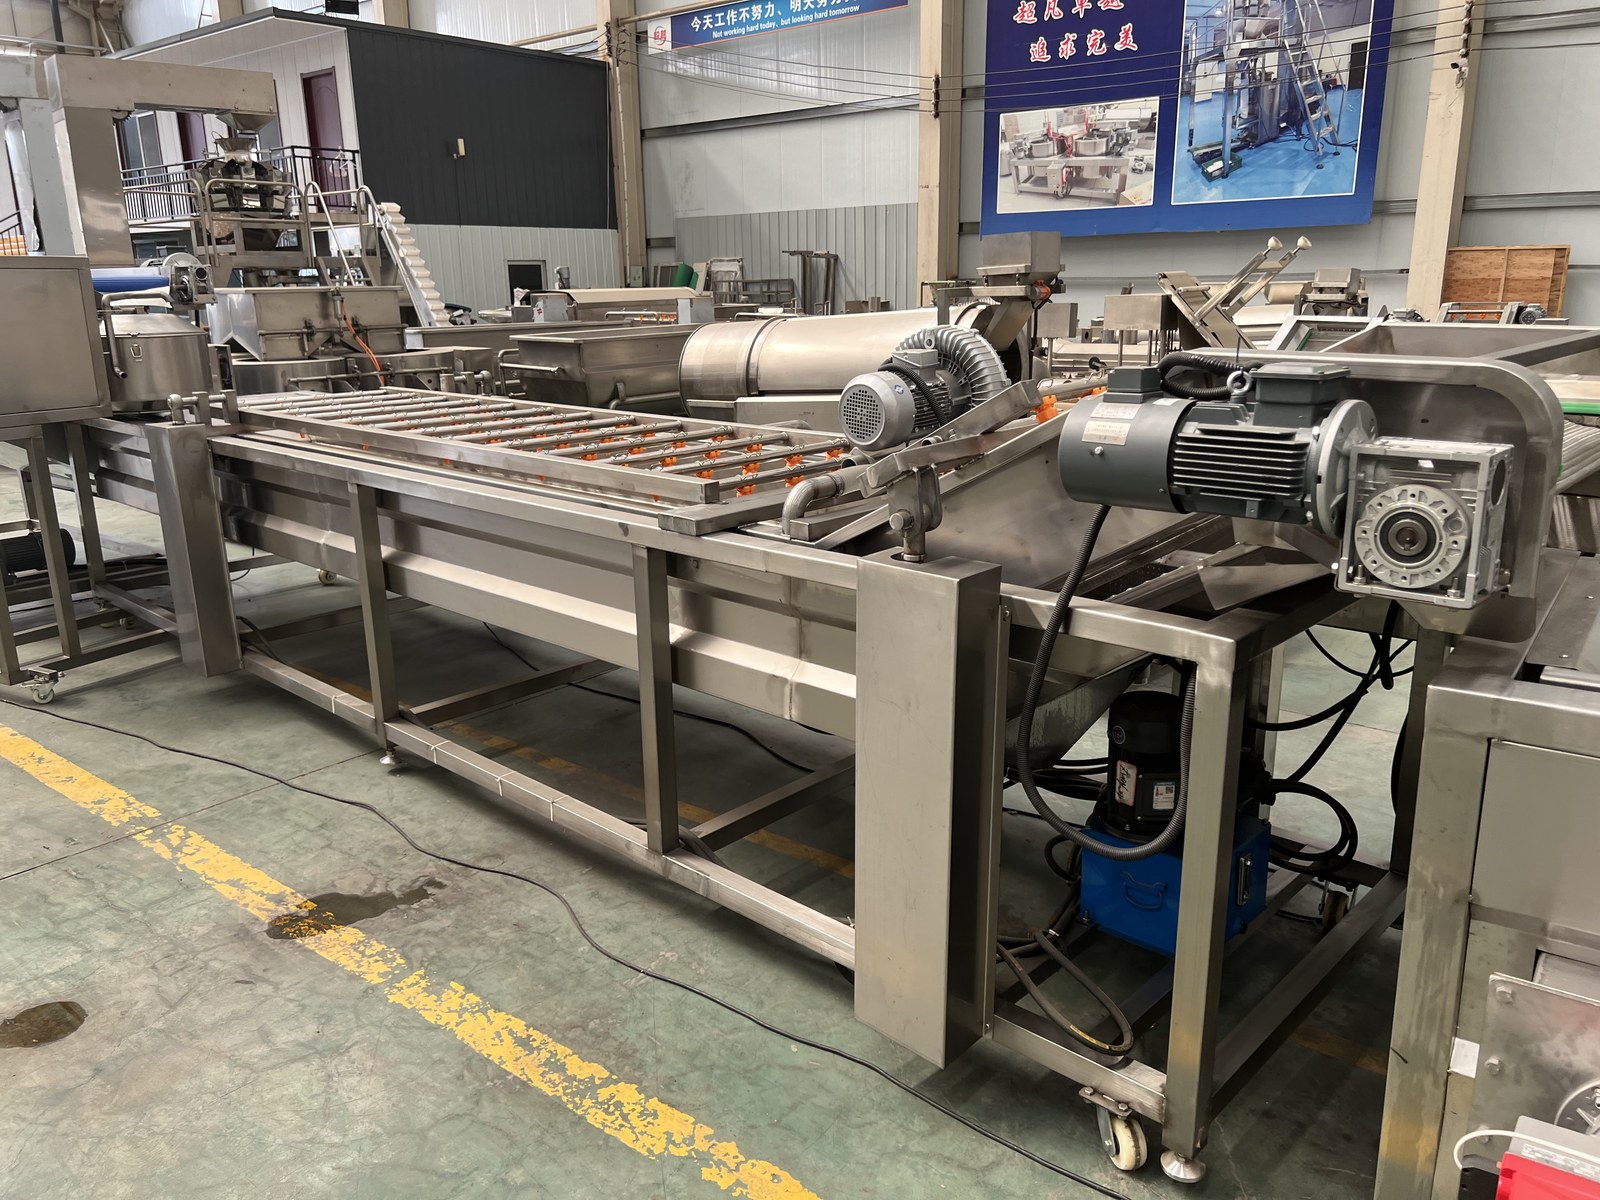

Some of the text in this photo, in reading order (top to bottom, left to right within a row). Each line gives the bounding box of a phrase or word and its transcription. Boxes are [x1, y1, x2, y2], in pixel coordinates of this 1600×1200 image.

[713, 30, 722, 39] Not
[724, 27, 745, 35] working
[746, 23, 759, 32] hard
[781, 18, 790, 26] but
[792, 12, 813, 22] looking
[814, 11, 828, 20] hard
[829, 5, 860, 16] tomorrow
[1030, 23, 1138, 62] 追求完美
